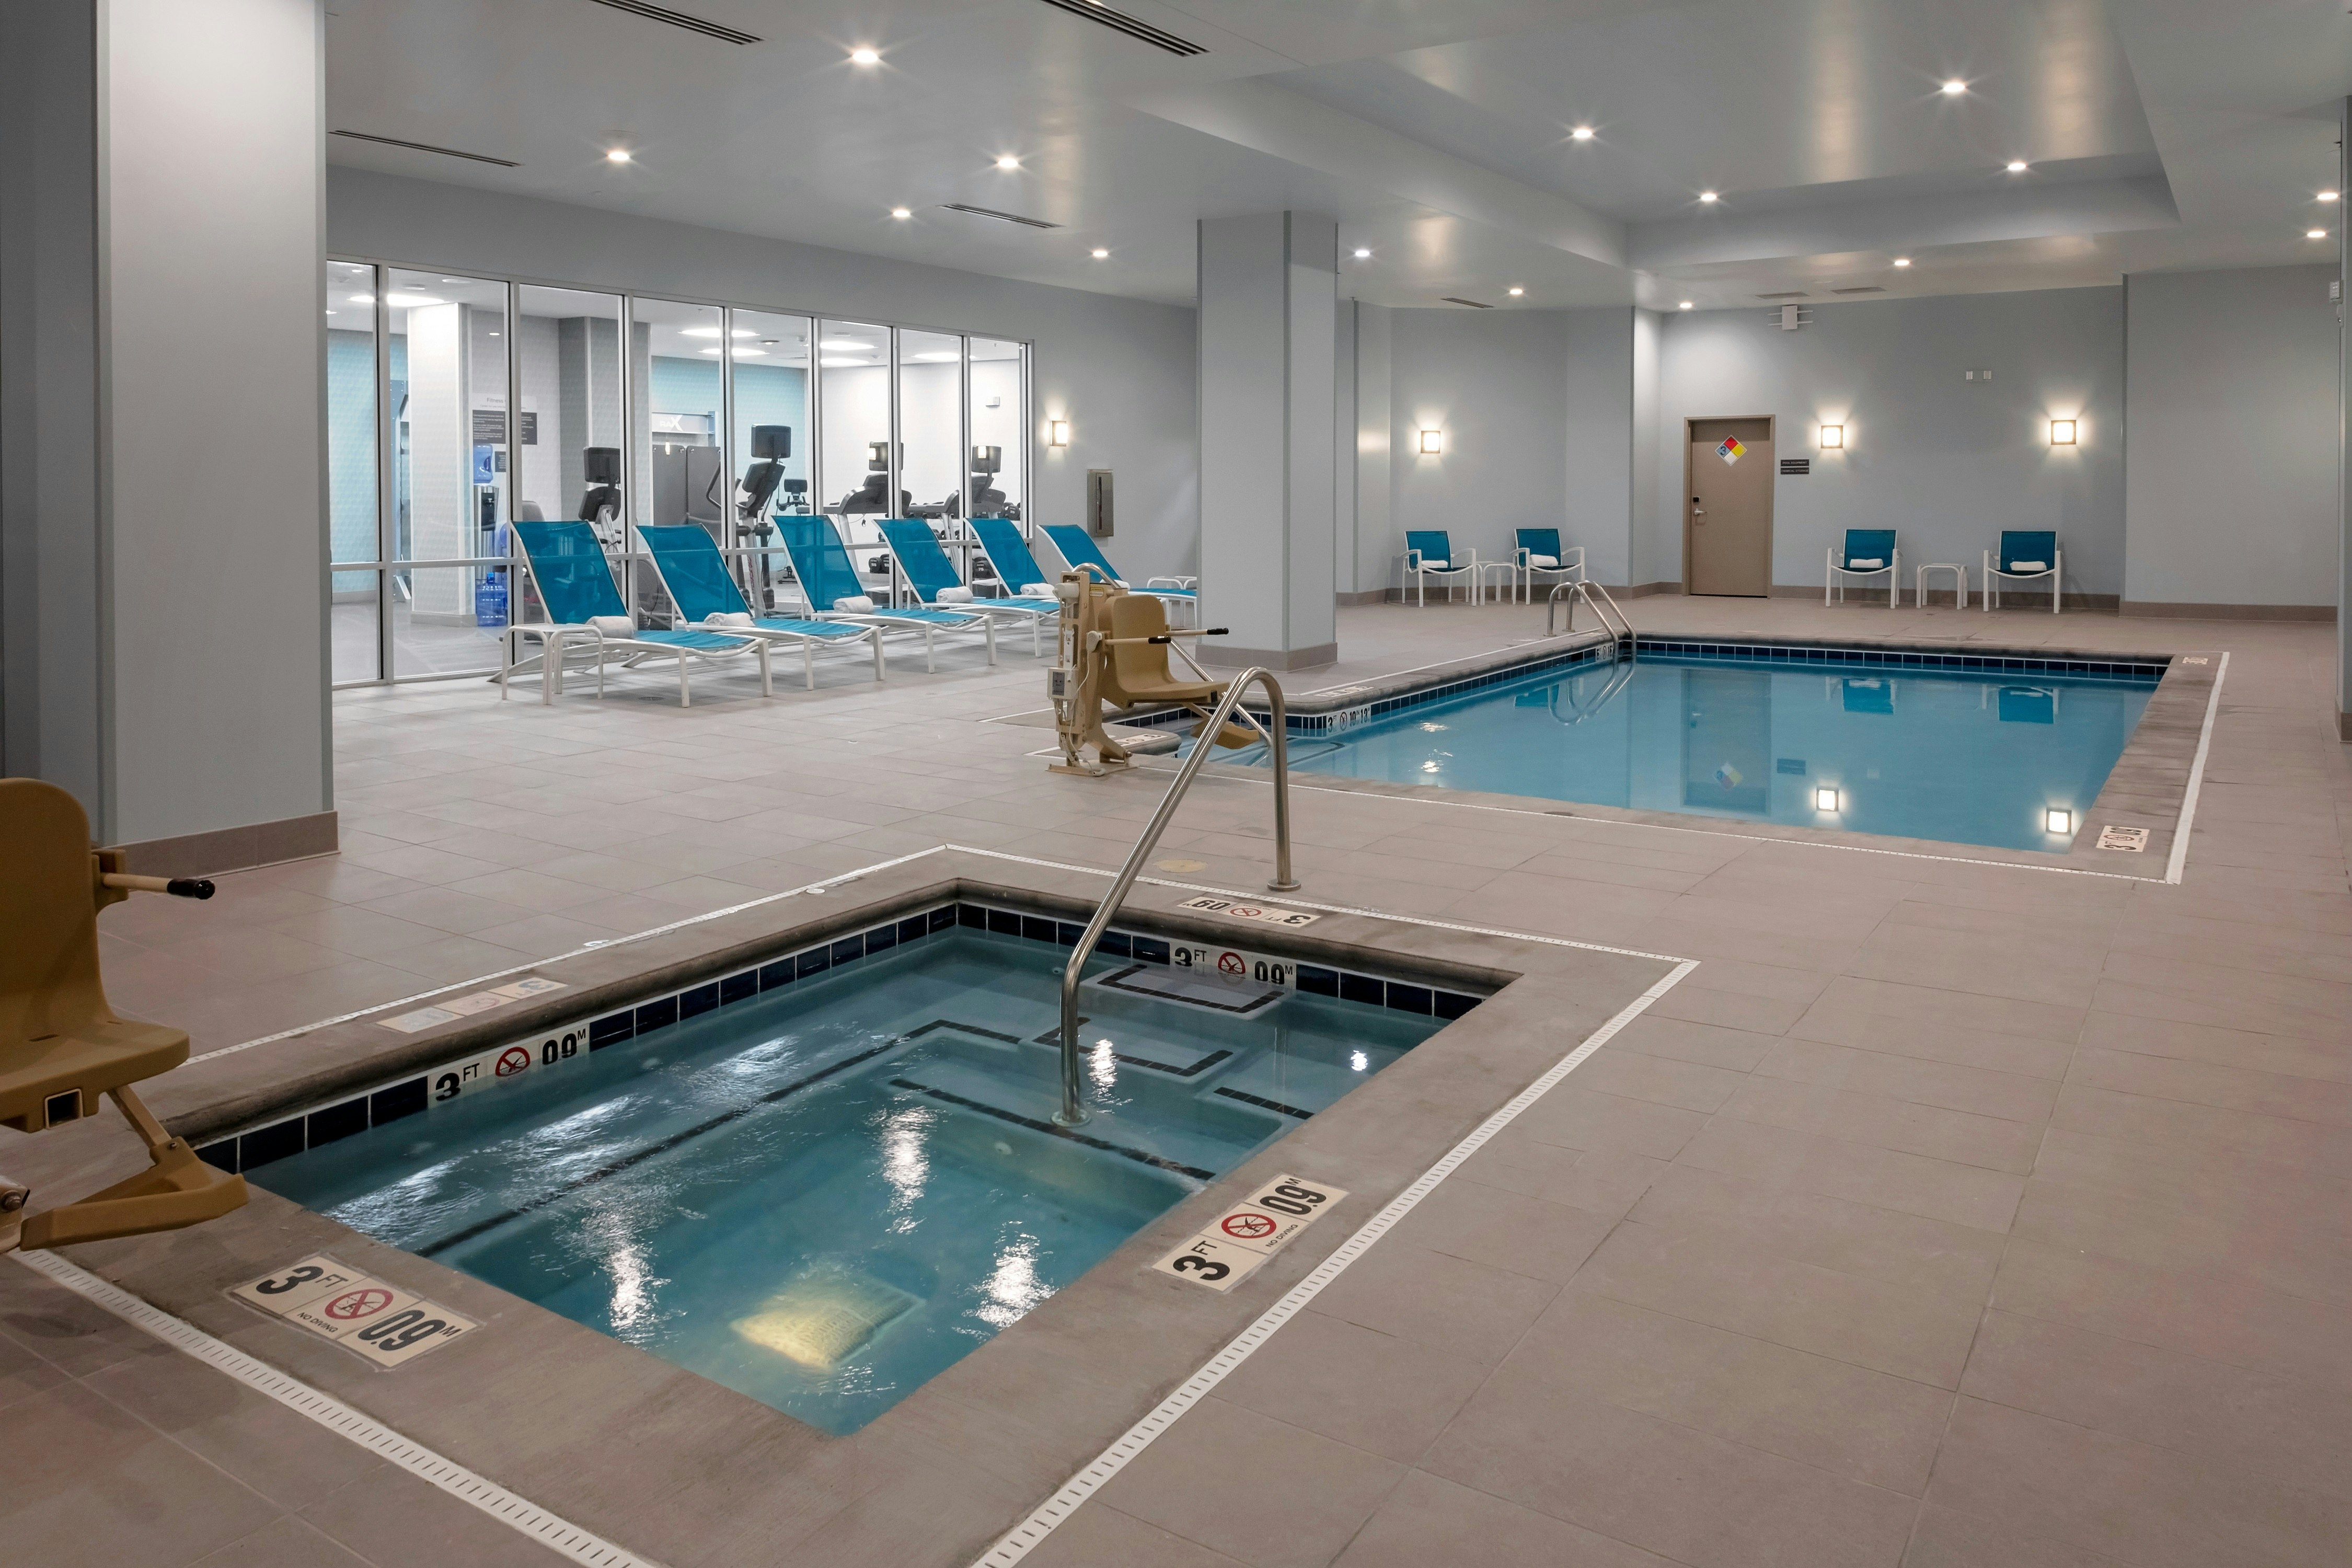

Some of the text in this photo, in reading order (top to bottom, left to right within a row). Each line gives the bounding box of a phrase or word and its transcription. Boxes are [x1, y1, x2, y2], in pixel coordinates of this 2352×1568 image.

[1720, 446, 1727, 456] 3
[1283, 915, 1311, 924] 3
[1174, 947, 1192, 967] 3
[1194, 949, 1207, 962] FT
[1285, 965, 1293, 975] M
[435, 1073, 461, 1101] 3
[463, 1063, 480, 1081] FT
[577, 1028, 586, 1040] M
[1284, 1178, 1301, 1186] M
[1277, 1224, 1298, 1240] DIVING
[1173, 1240, 1230, 1281] 3 FT
[256, 1265, 324, 1295] 3
[315, 1273, 349, 1288] FT
[439, 1325, 459, 1337] M
[297, 1311, 338, 1333] NO DIVING
